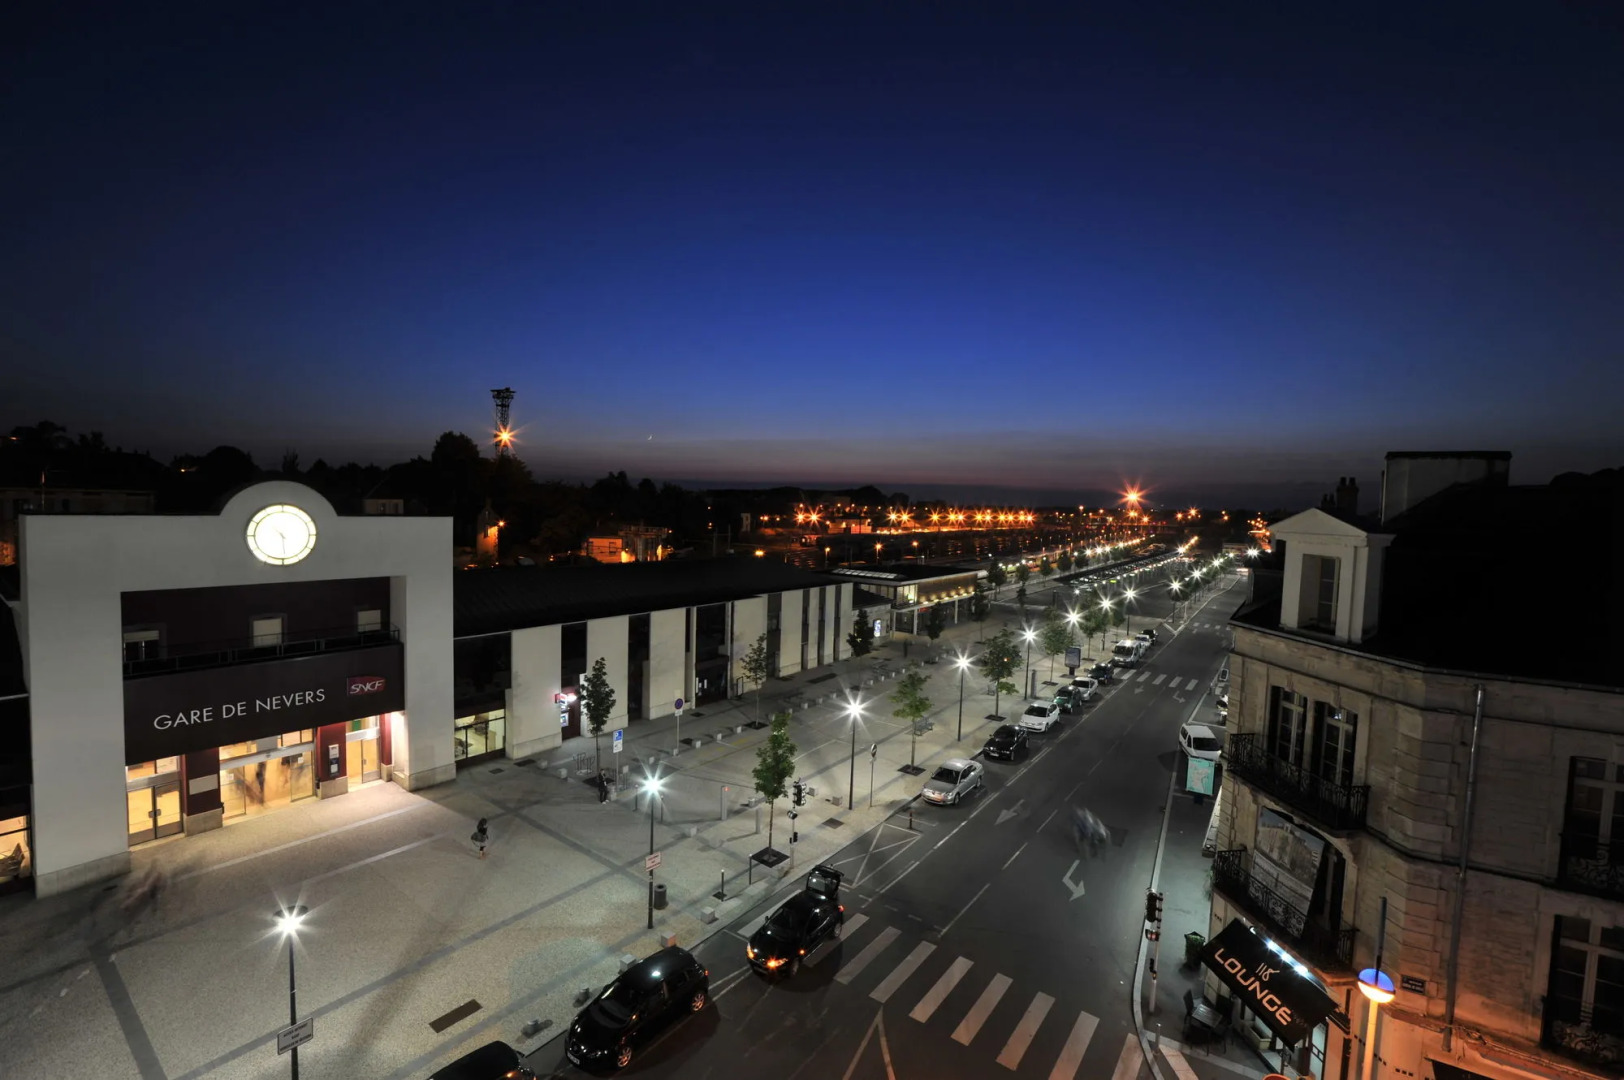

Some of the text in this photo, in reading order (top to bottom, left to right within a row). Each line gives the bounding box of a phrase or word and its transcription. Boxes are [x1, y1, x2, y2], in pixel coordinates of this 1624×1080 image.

[349, 679, 385, 694] SNCF
[153, 688, 326, 730] GARE DE NEVERS
[1214, 947, 1293, 1026] LOUNGE
